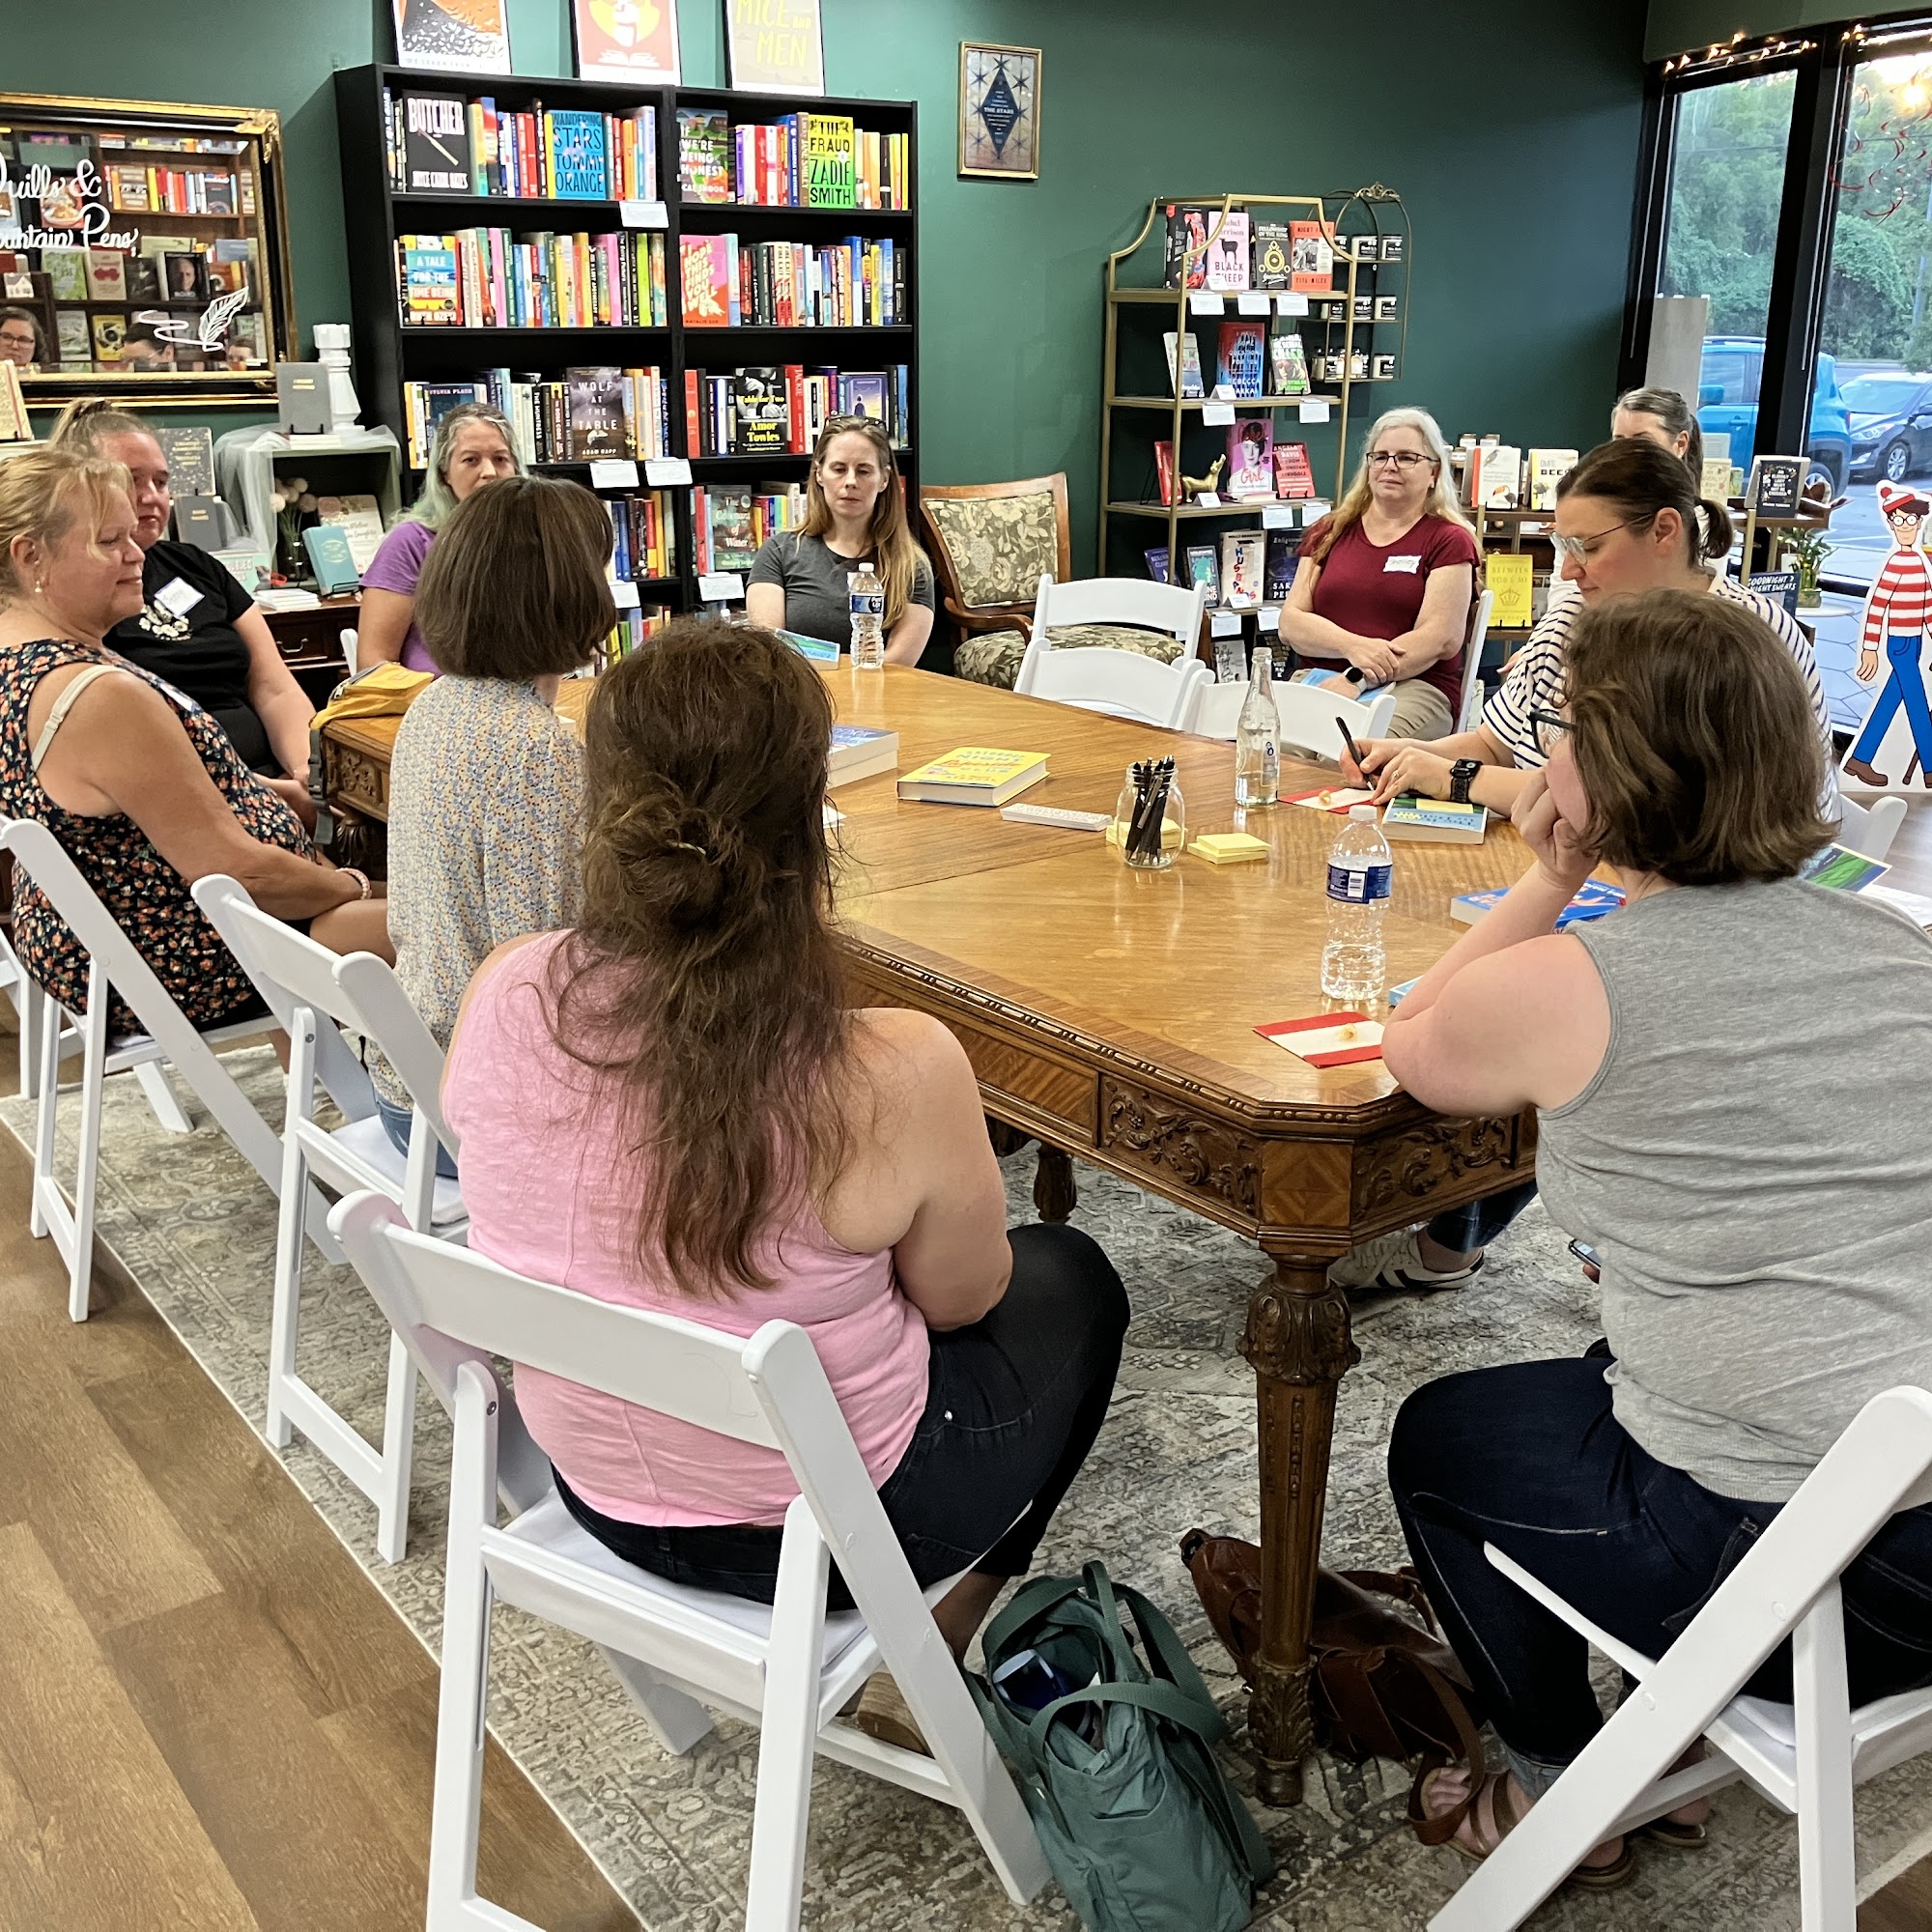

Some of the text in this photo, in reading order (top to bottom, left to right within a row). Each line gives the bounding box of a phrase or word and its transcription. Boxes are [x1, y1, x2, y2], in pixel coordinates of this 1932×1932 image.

[756, 31, 807, 67] MEN
[407, 98, 465, 135] BUTCHER
[553, 112, 602, 127] WANDERING
[554, 128, 602, 150] STARS
[680, 139, 714, 151] WE'RE
[810, 137, 850, 153] FRAUD
[554, 153, 603, 170] TOMMY
[680, 153, 715, 163] BEING
[69, 158, 102, 197] &
[680, 164, 724, 176] HONEST
[810, 158, 850, 185] ZADIE
[555, 173, 604, 192] ORANGE
[810, 187, 851, 205] SMITH
[79, 202, 138, 254] Pens
[425, 256, 446, 267] TALE
[1214, 262, 1243, 270] BLACK
[578, 381, 613, 391] WOLF
[794, 369, 804, 397] JACKIE
[579, 419, 617, 431] TABLE
[750, 422, 777, 431] Amor
[1241, 467, 1264, 484] Girl
[725, 538, 749, 548] Water
[955, 753, 1024, 762] NIGHT
